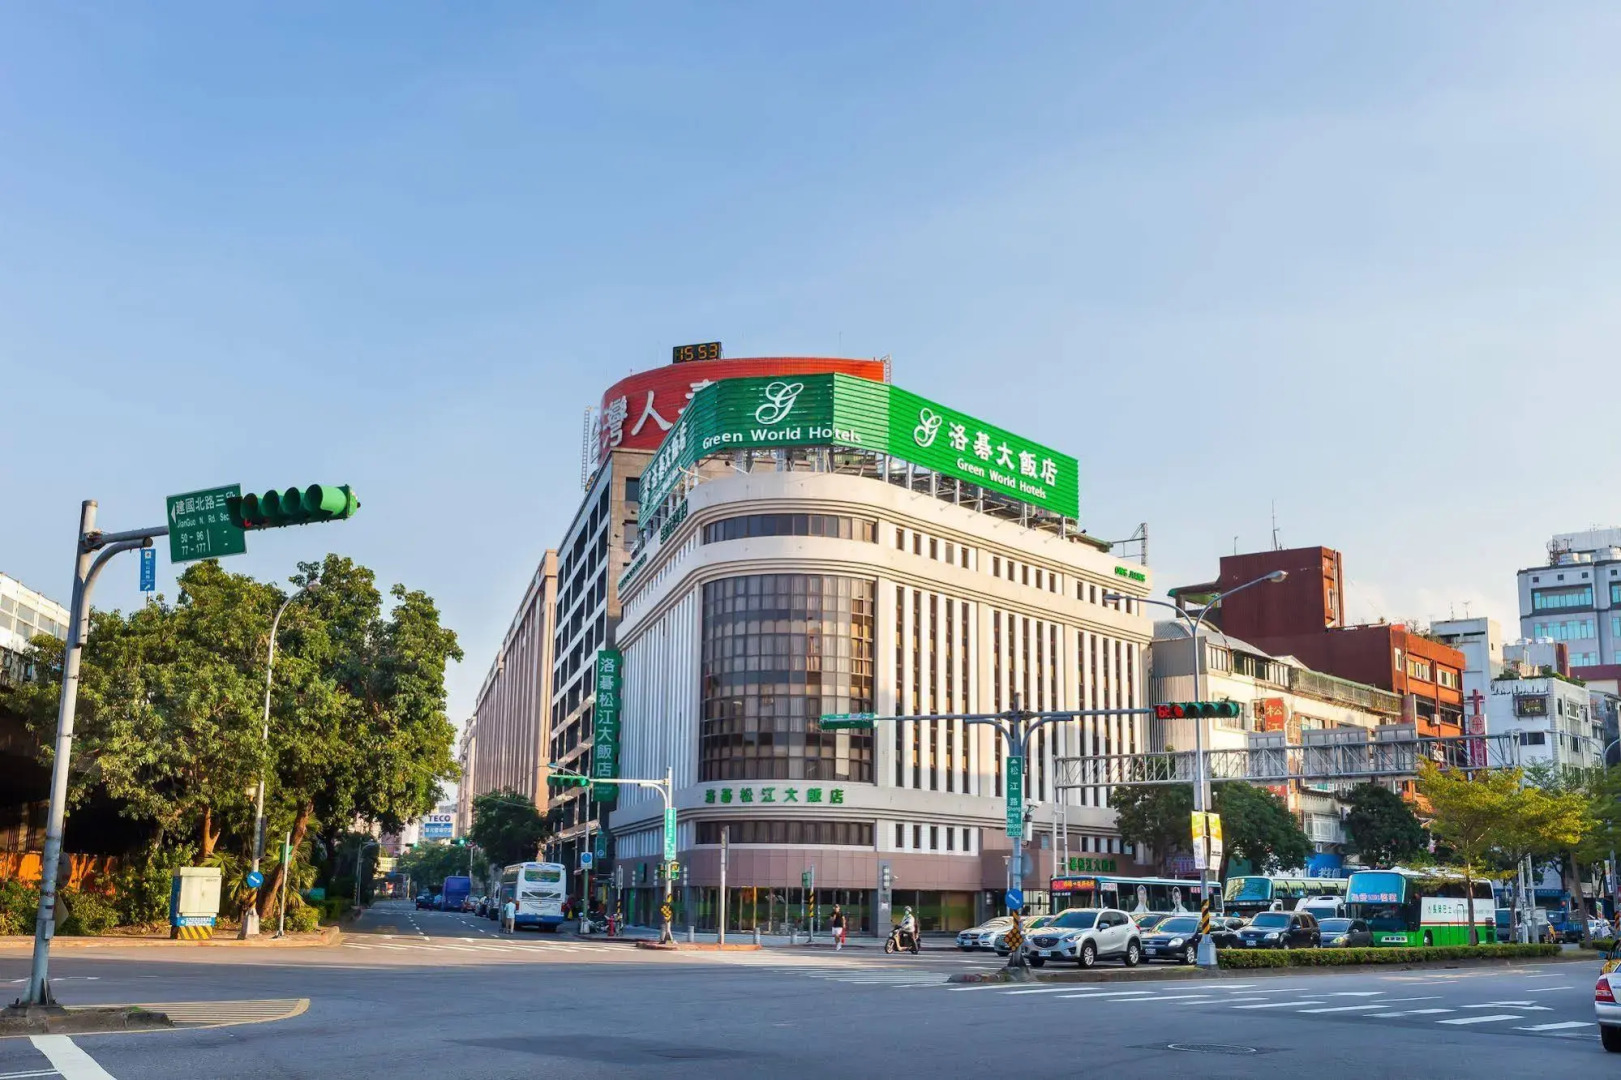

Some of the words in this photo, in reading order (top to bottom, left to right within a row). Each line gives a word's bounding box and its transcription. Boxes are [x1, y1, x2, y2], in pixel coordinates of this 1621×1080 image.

[702, 431, 744, 450] Green
[750, 427, 801, 442] World
[808, 426, 862, 444] Hotels
[948, 422, 1058, 487] 洛碁大飯店
[956, 457, 985, 477] Green
[989, 468, 1016, 489] World
[1019, 480, 1047, 499] Hotels
[597, 657, 615, 777] 洛碁松江大飯店
[1266, 704, 1283, 731] 松江
[1009, 766, 1019, 806] 松江路
[429, 814, 451, 822] TECO
